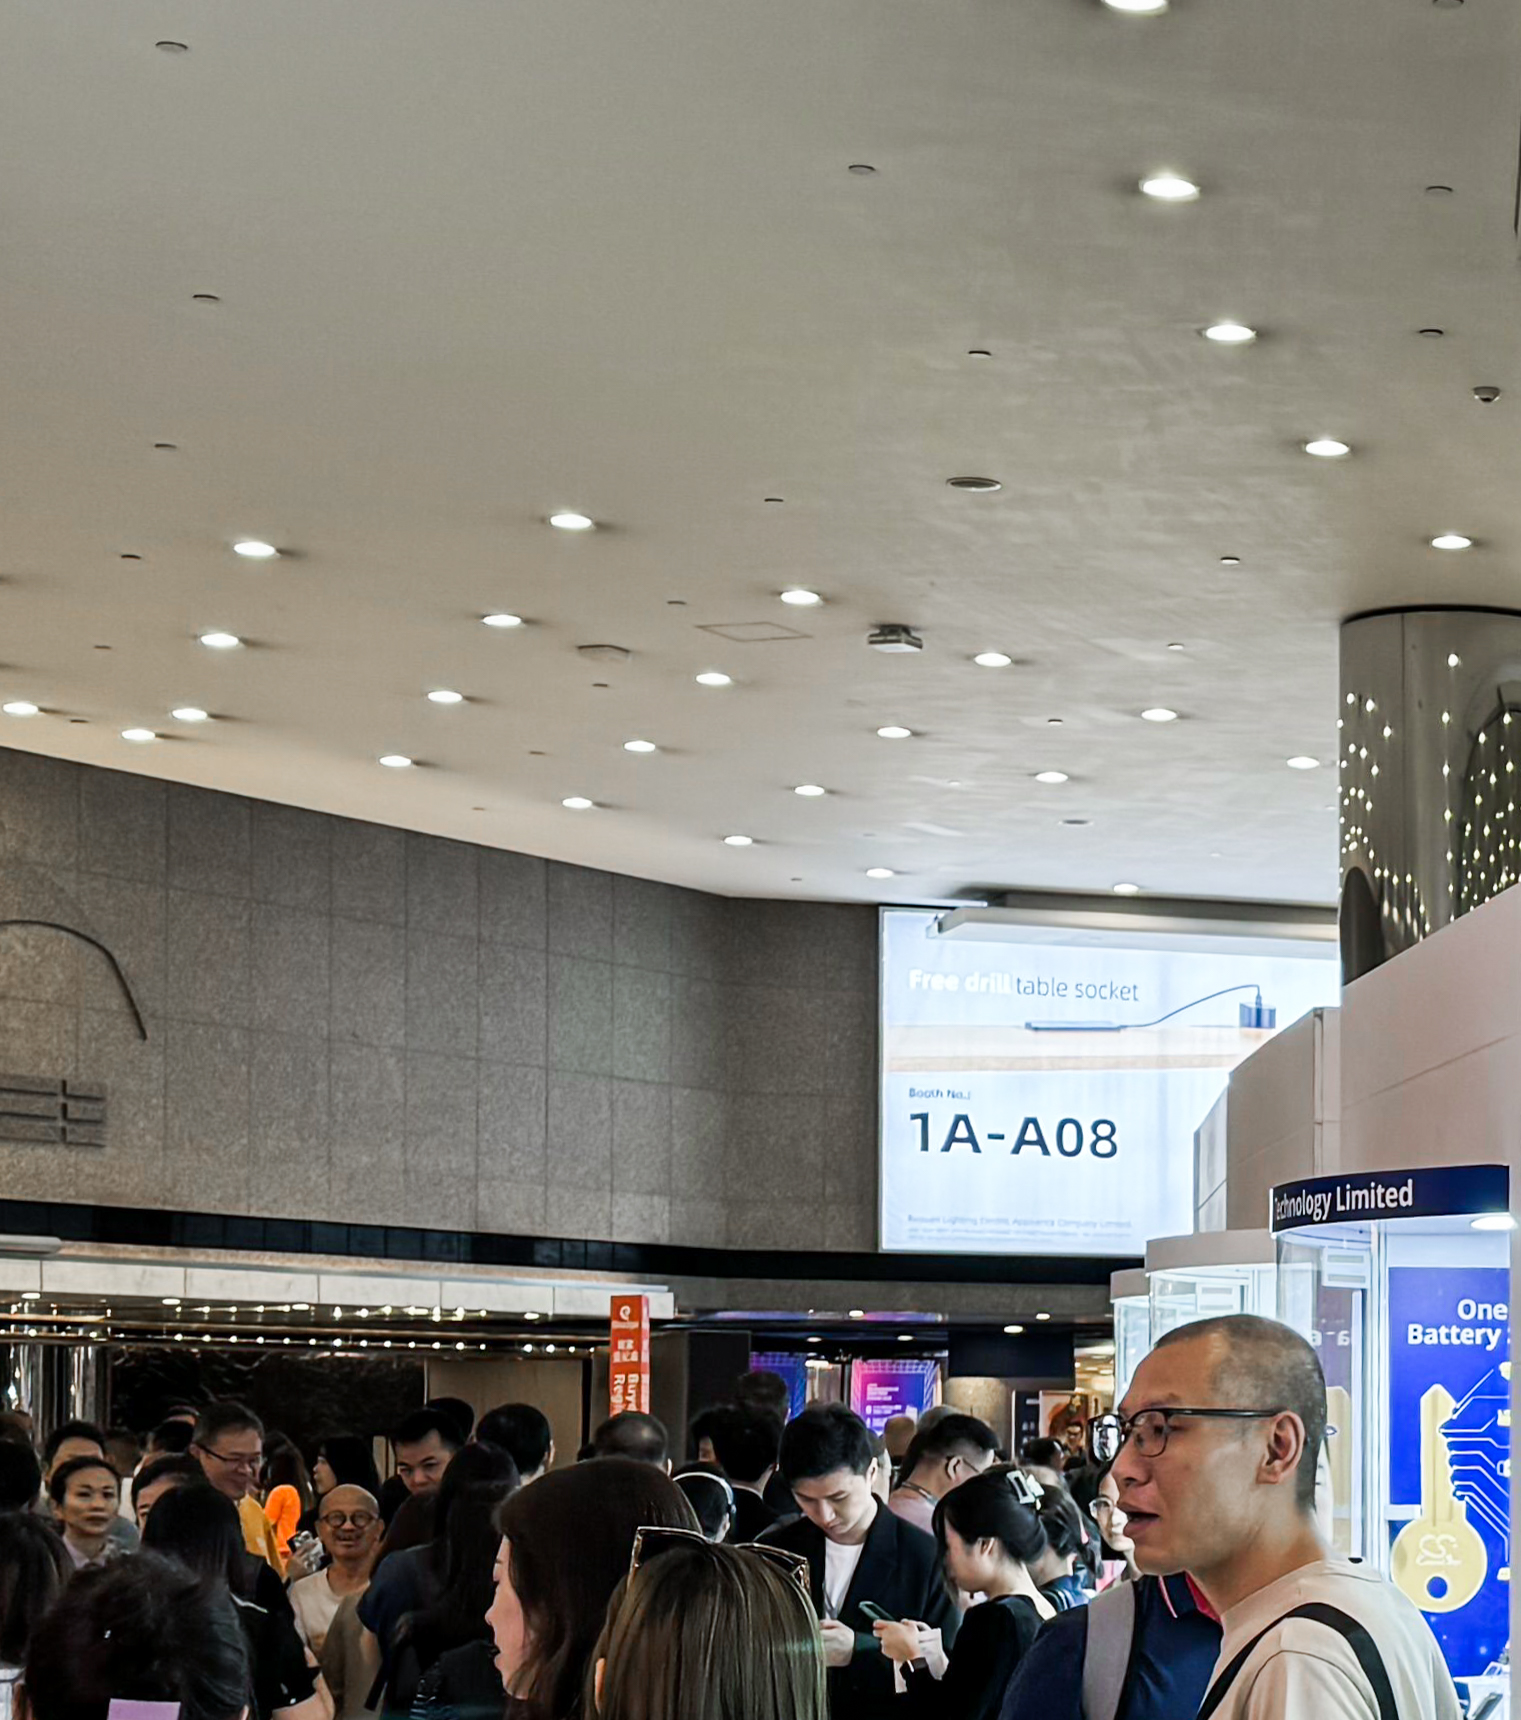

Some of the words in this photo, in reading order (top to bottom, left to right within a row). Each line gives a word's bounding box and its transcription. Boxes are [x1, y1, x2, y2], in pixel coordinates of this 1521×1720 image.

[908, 968, 960, 992] Free
[965, 971, 1012, 995] drill
[1016, 977, 1068, 998] table
[1075, 980, 1140, 1002] socket
[909, 1087, 943, 1099] Booth
[909, 1112, 1118, 1159] 1A-A08
[1336, 1178, 1414, 1212] Limited
[1457, 1299, 1509, 1321] One
[1407, 1323, 1502, 1351] Battery
